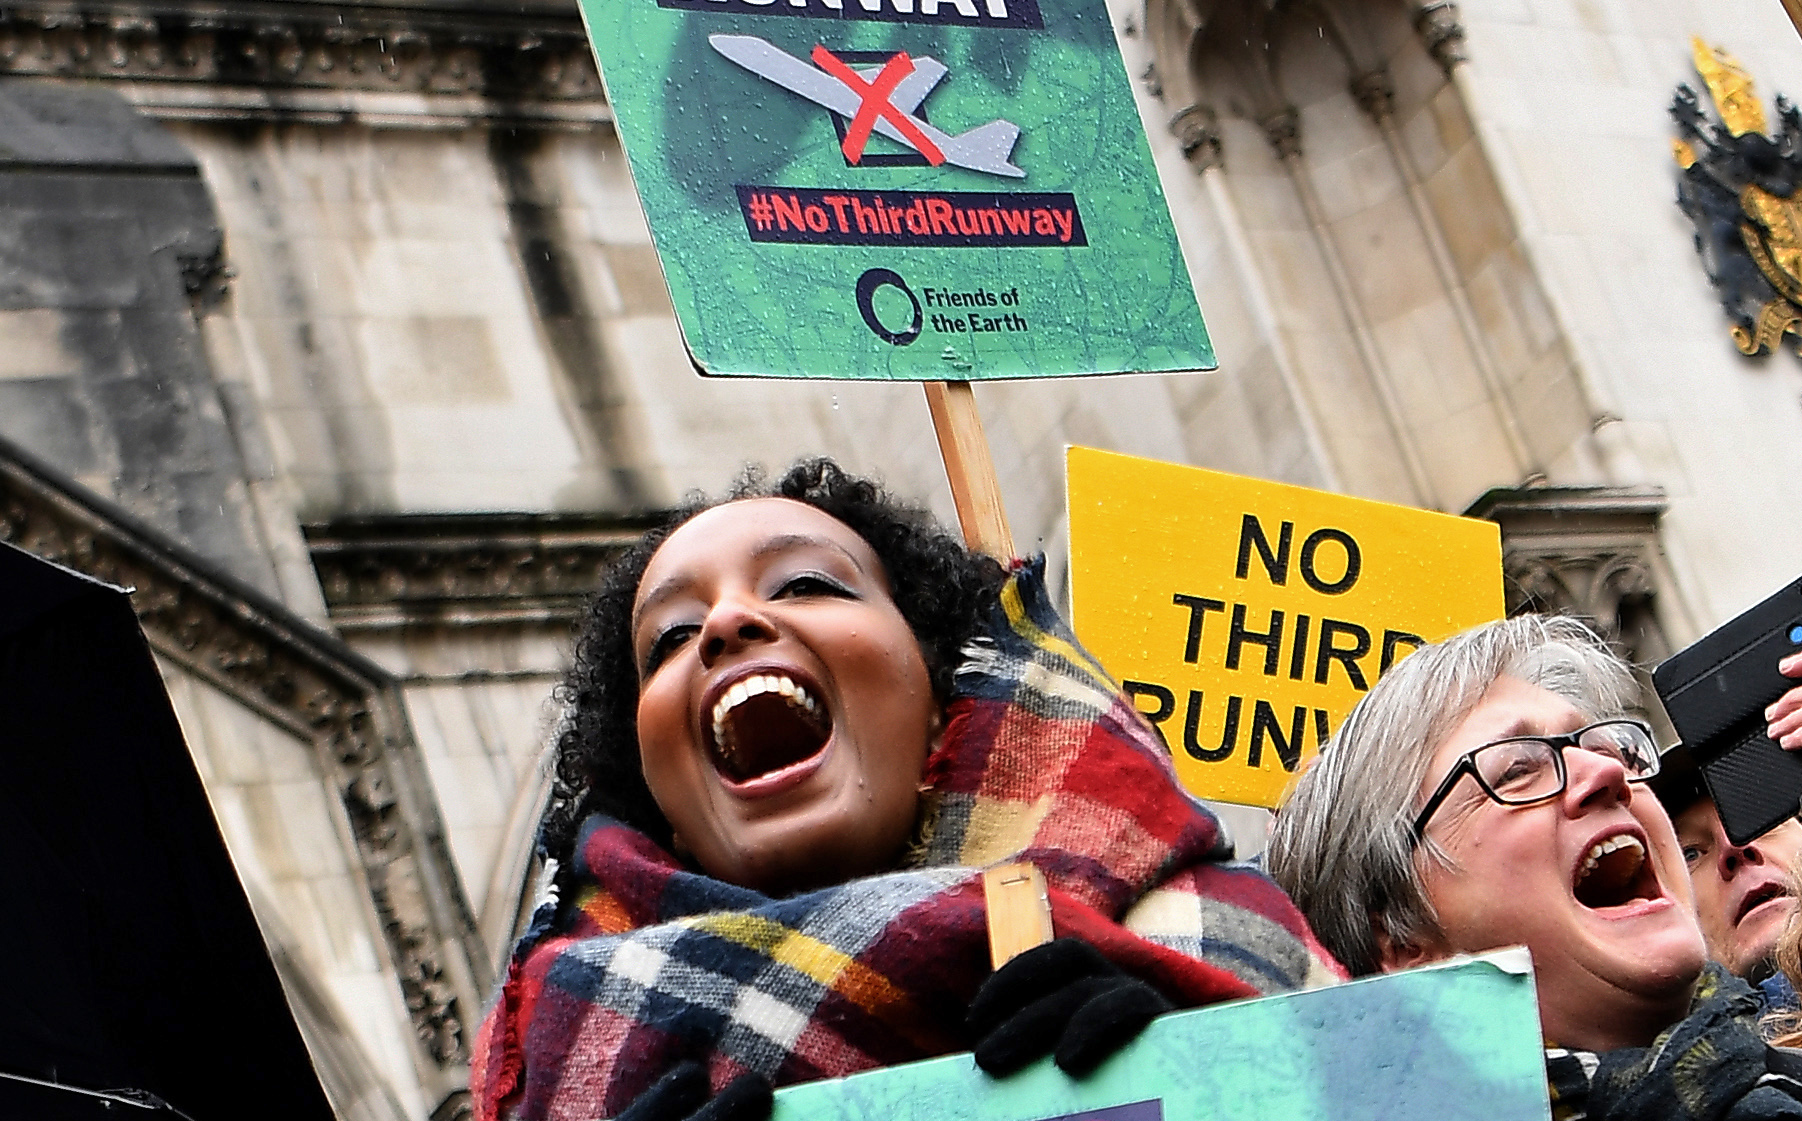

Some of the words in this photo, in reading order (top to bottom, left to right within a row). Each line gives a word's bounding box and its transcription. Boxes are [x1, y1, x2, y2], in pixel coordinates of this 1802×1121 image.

[748, 193, 1073, 242] #NoThirdRunway
[923, 287, 996, 308] Friends
[1000, 288, 1020, 307] of
[931, 315, 967, 333] the
[969, 313, 1028, 333] Earth
[1235, 513, 1362, 595] NO
[1121, 679, 1331, 774] RUN
